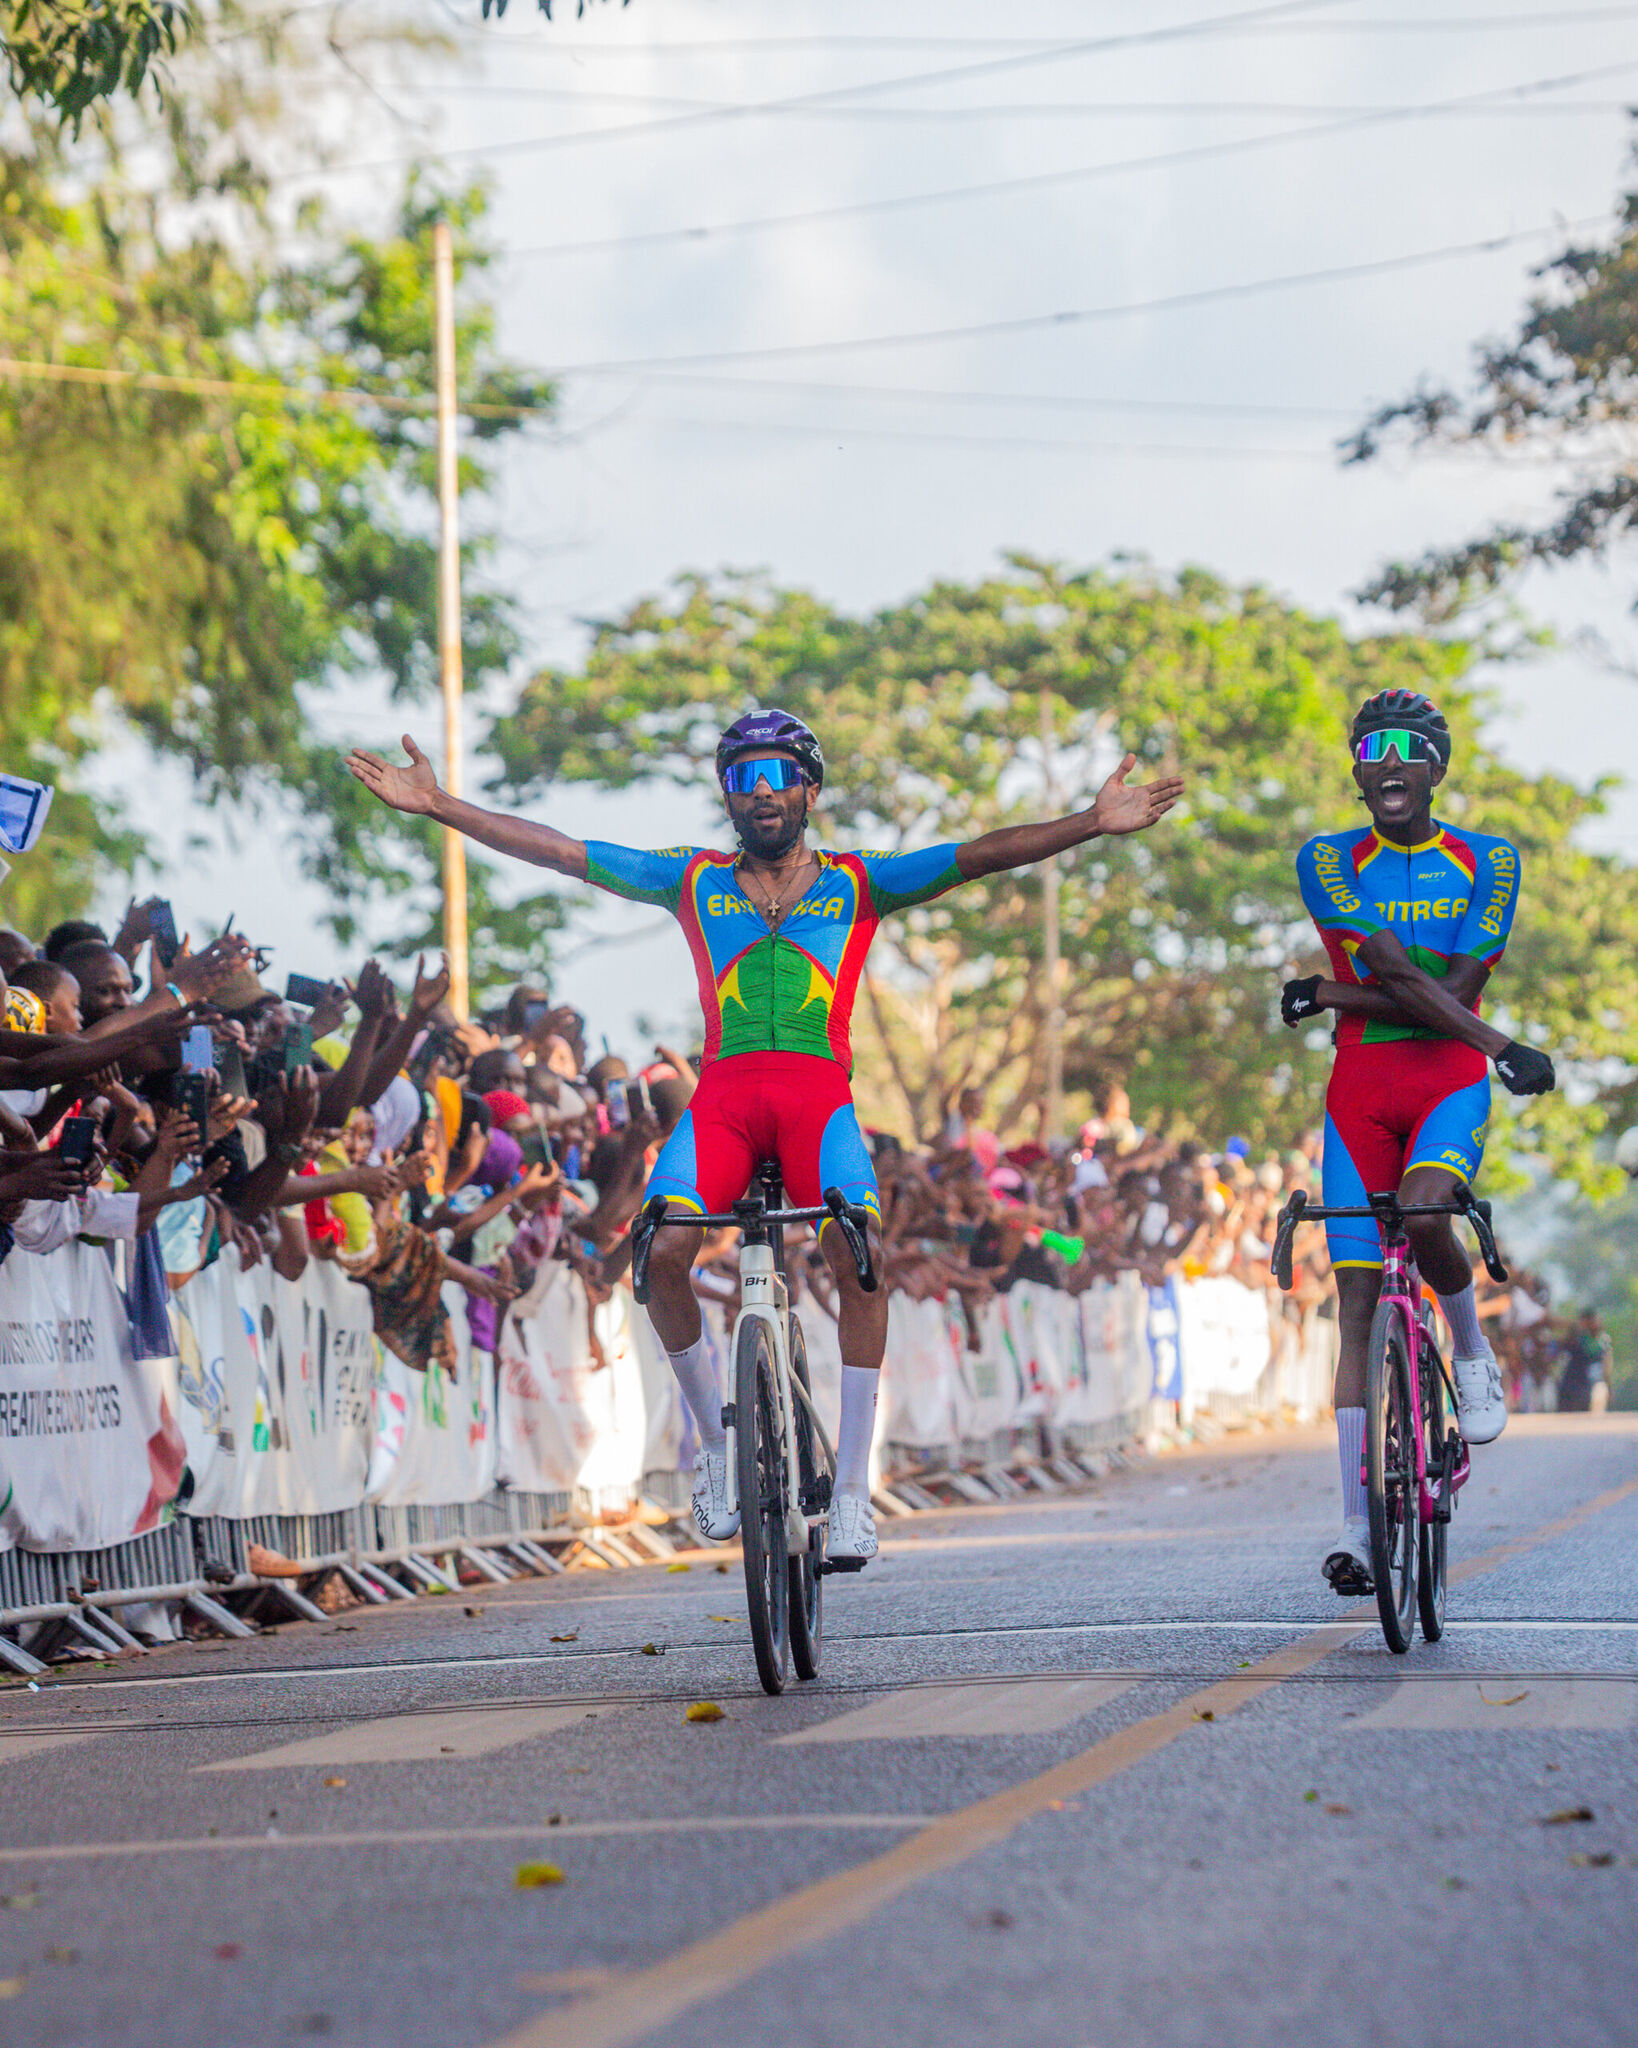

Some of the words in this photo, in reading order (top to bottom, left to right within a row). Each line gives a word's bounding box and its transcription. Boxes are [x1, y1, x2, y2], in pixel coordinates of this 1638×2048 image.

[1313, 843, 1361, 912] ERITREA
[1479, 846, 1516, 936] ERITREA
[744, 1276, 768, 1287] BH
